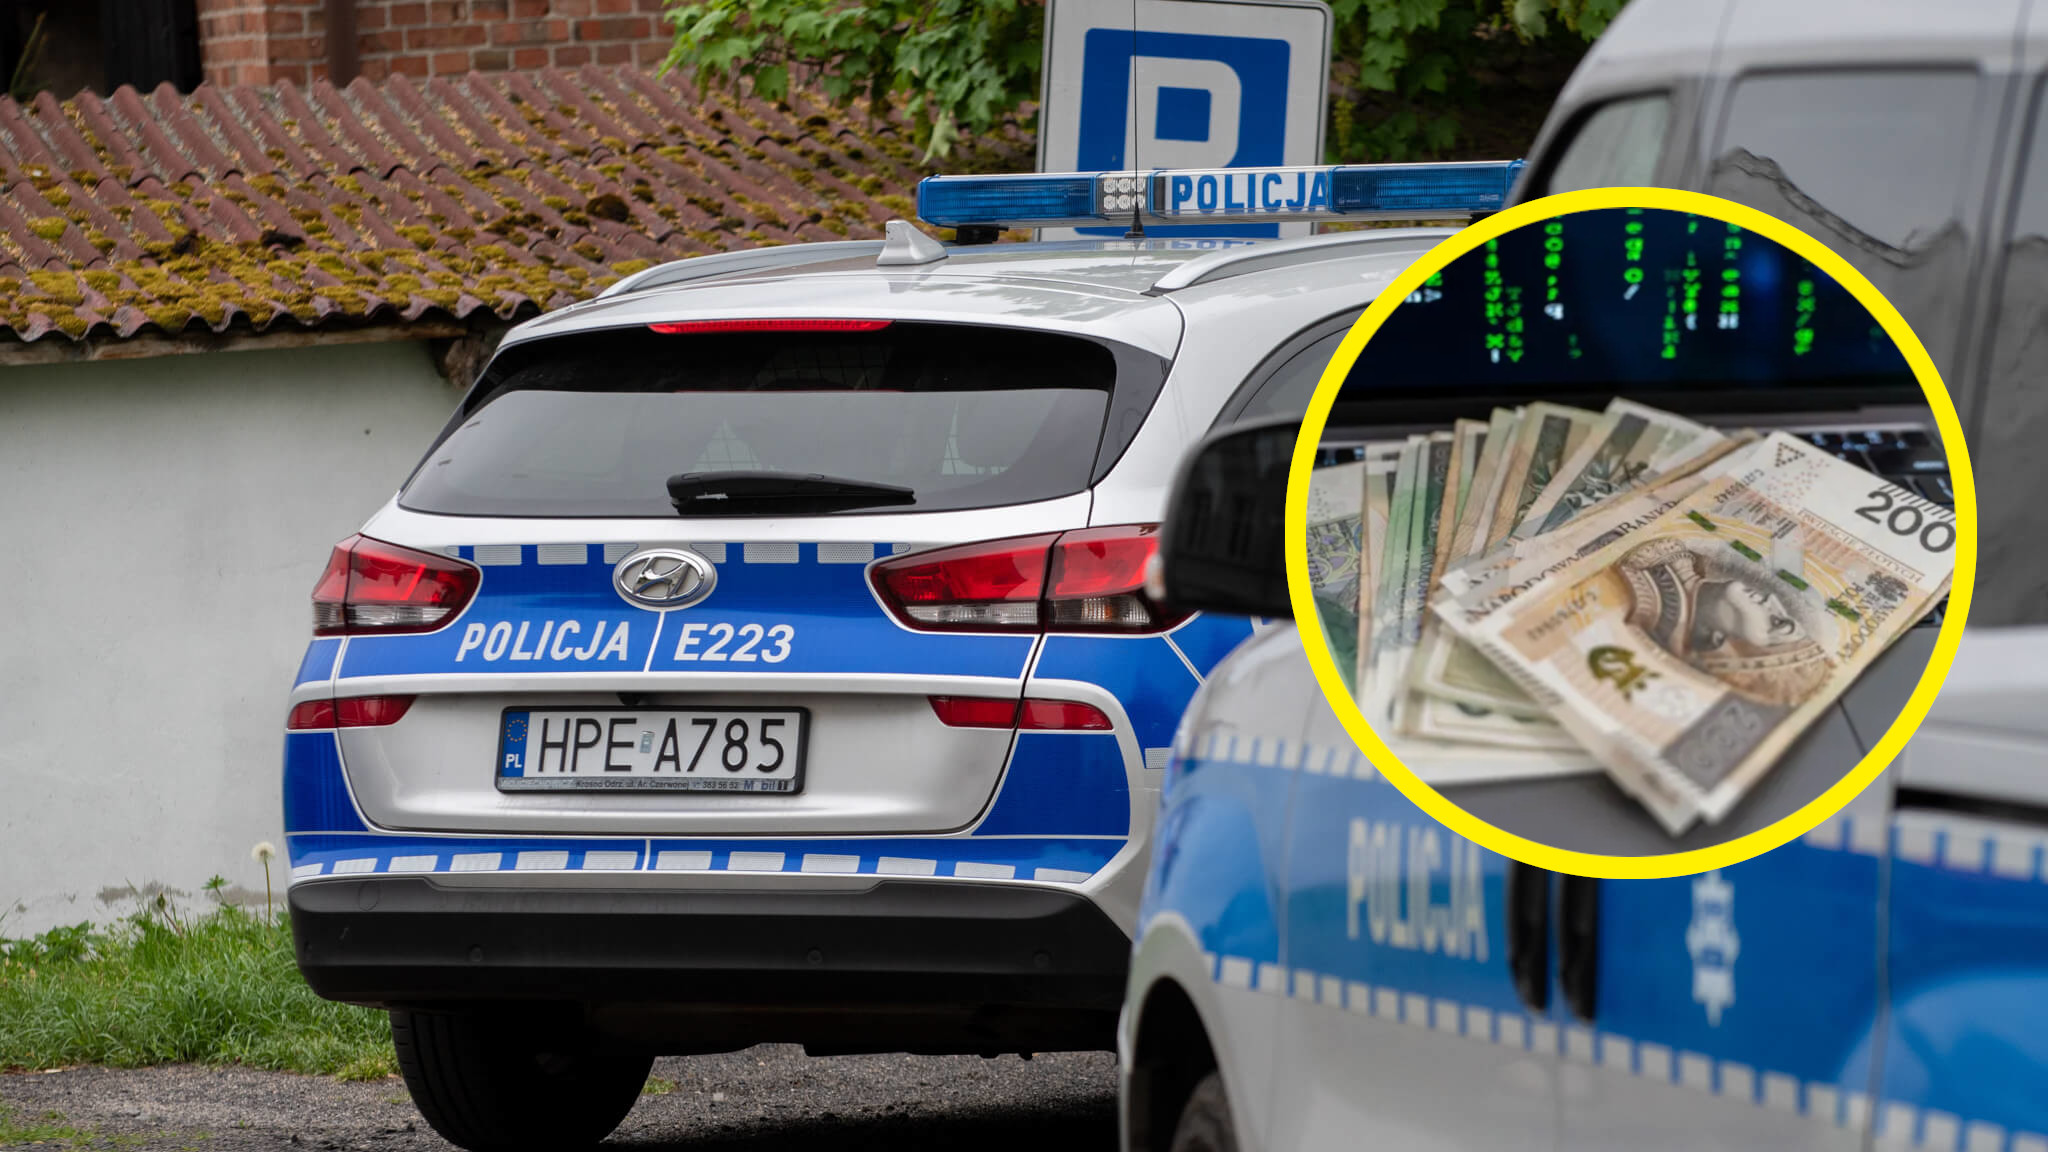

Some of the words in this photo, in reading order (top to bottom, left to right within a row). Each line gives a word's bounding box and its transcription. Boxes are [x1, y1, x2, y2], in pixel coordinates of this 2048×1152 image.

[1122, 55, 1242, 172] P
[1171, 171, 1329, 212] POLICJA
[1854, 490, 1957, 553] 200
[455, 620, 630, 663] POLICJA
[674, 623, 795, 664] E223
[505, 753, 523, 769] PL
[538, 717, 637, 773] HPE
[653, 717, 785, 773] A785
[1347, 815, 1490, 963] POLICJA
